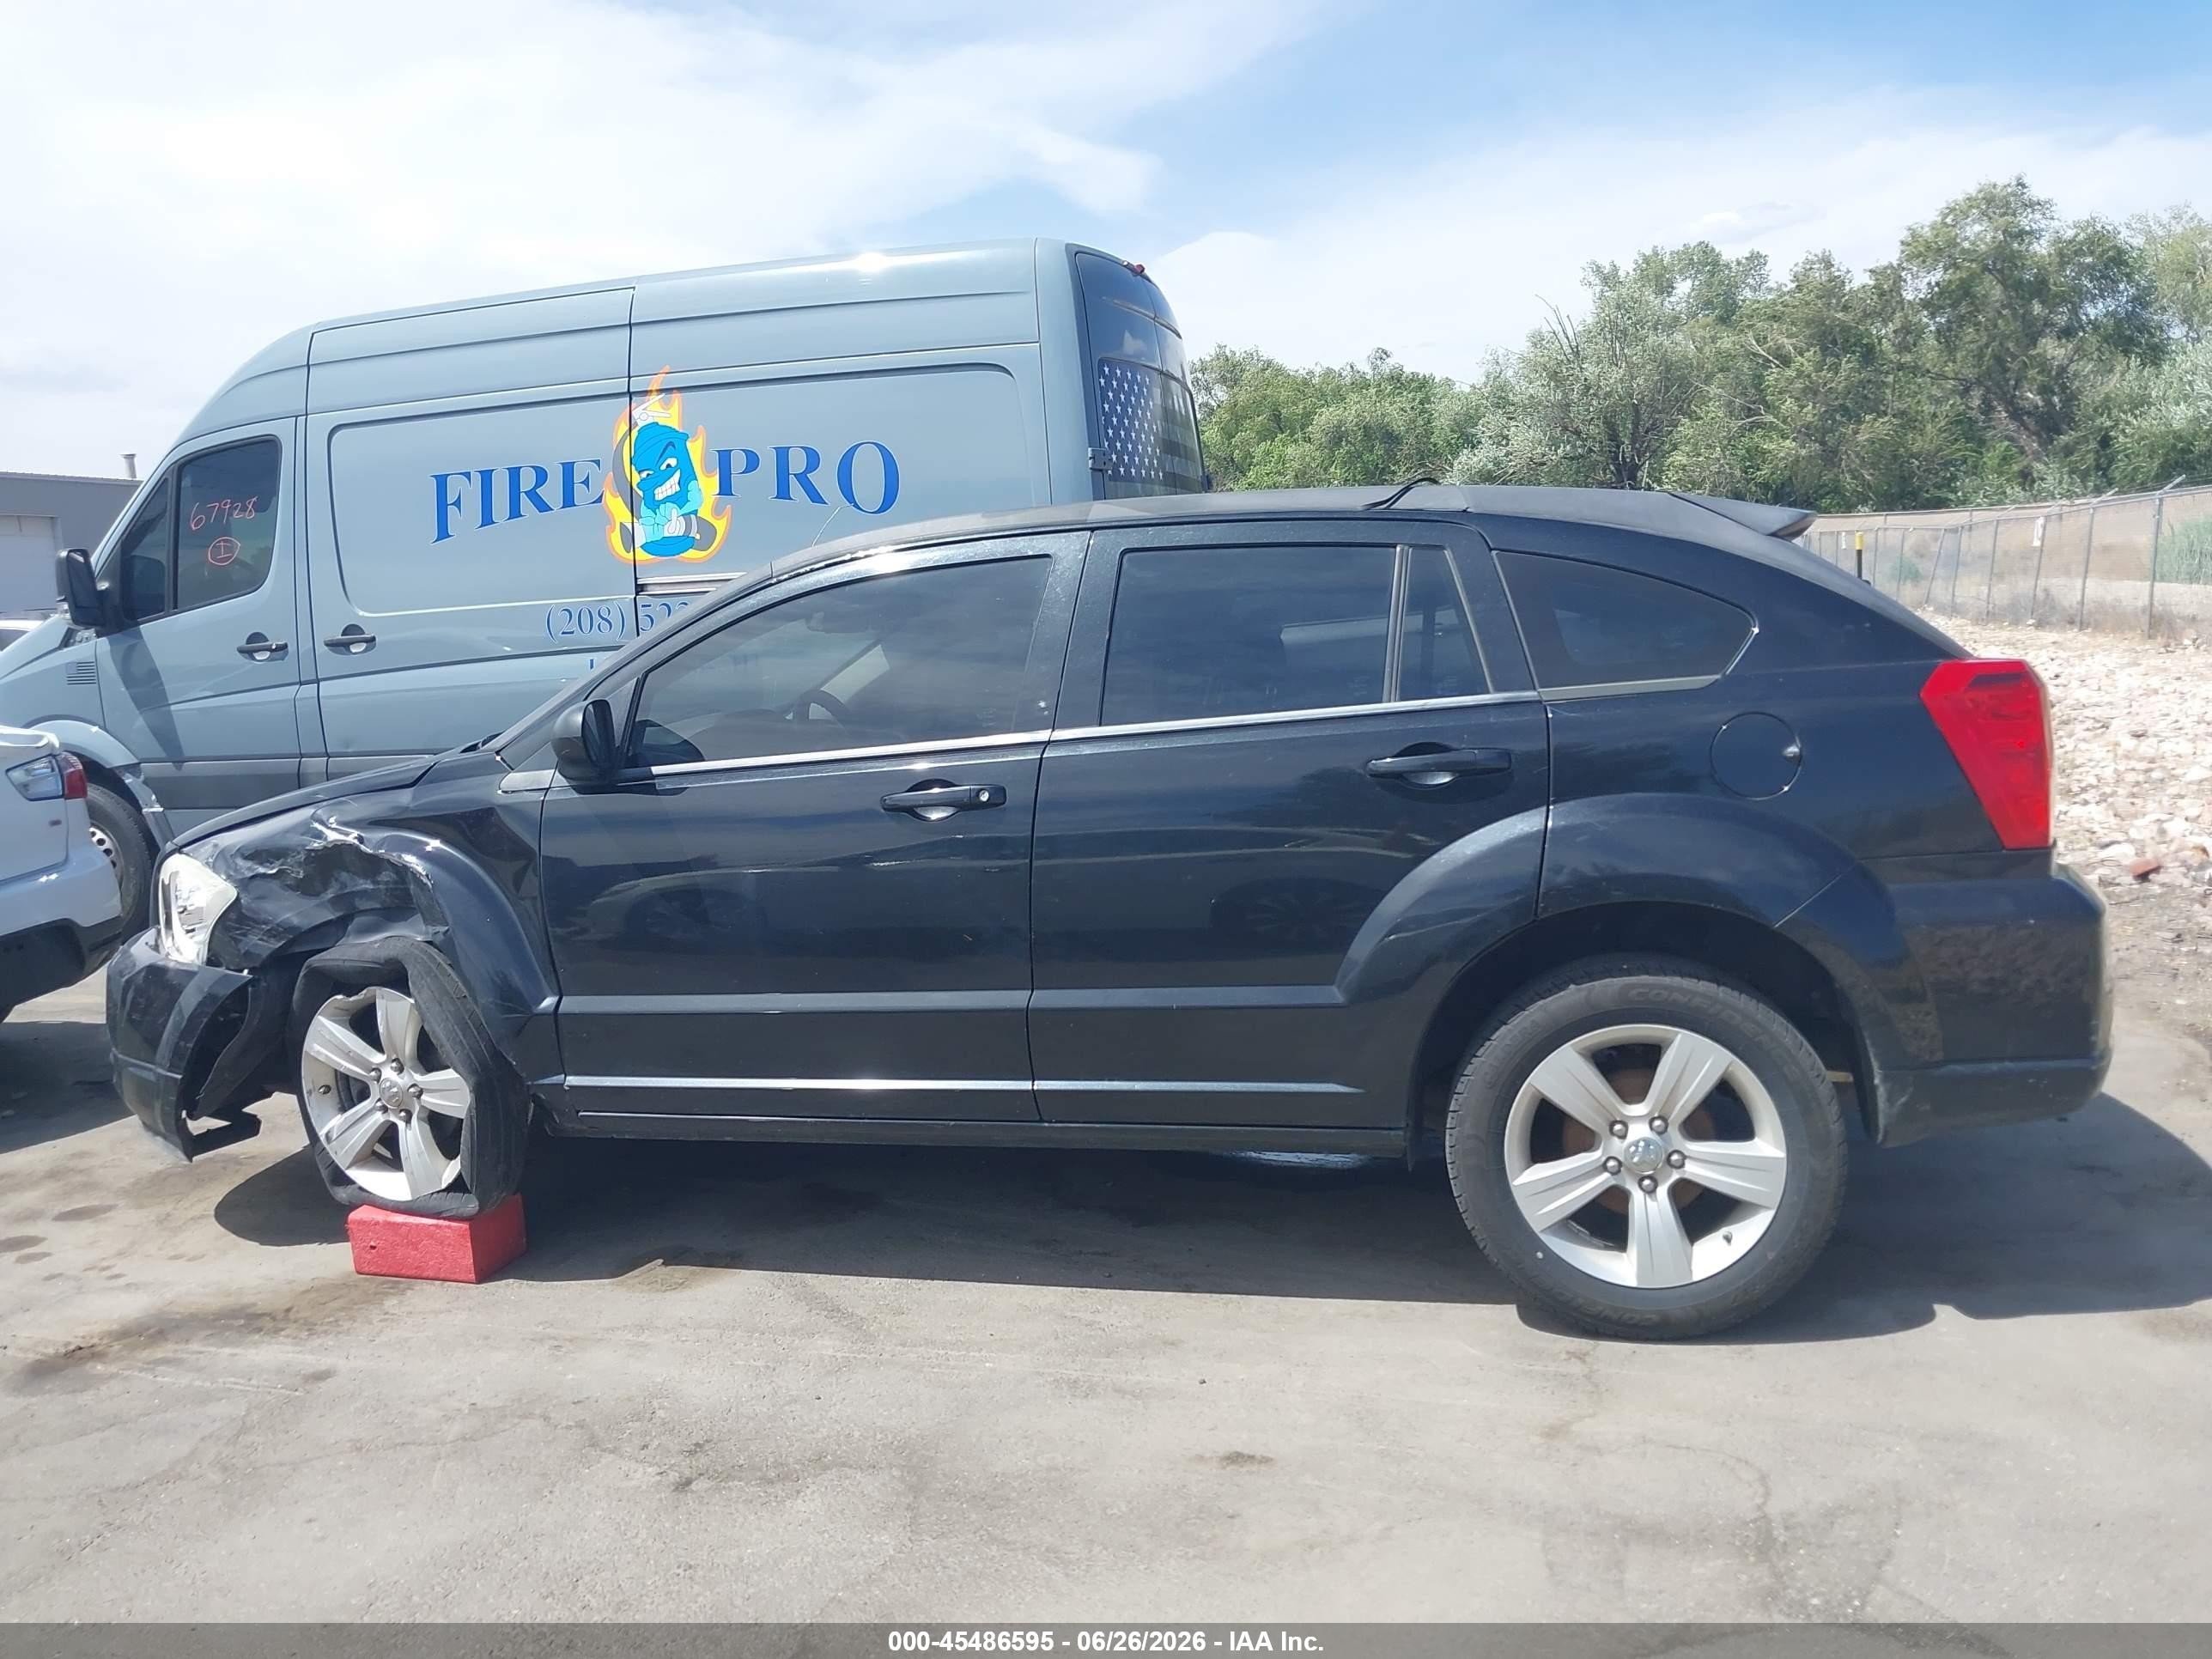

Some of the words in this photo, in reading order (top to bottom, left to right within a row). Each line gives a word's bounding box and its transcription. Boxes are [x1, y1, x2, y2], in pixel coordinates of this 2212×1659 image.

[190, 496, 258, 531] 67928
[430, 459, 605, 544] FIRE
[712, 441, 901, 515] PRO
[546, 601, 627, 643] (208)
[1628, 988, 1802, 1082] CONFIDENCE
